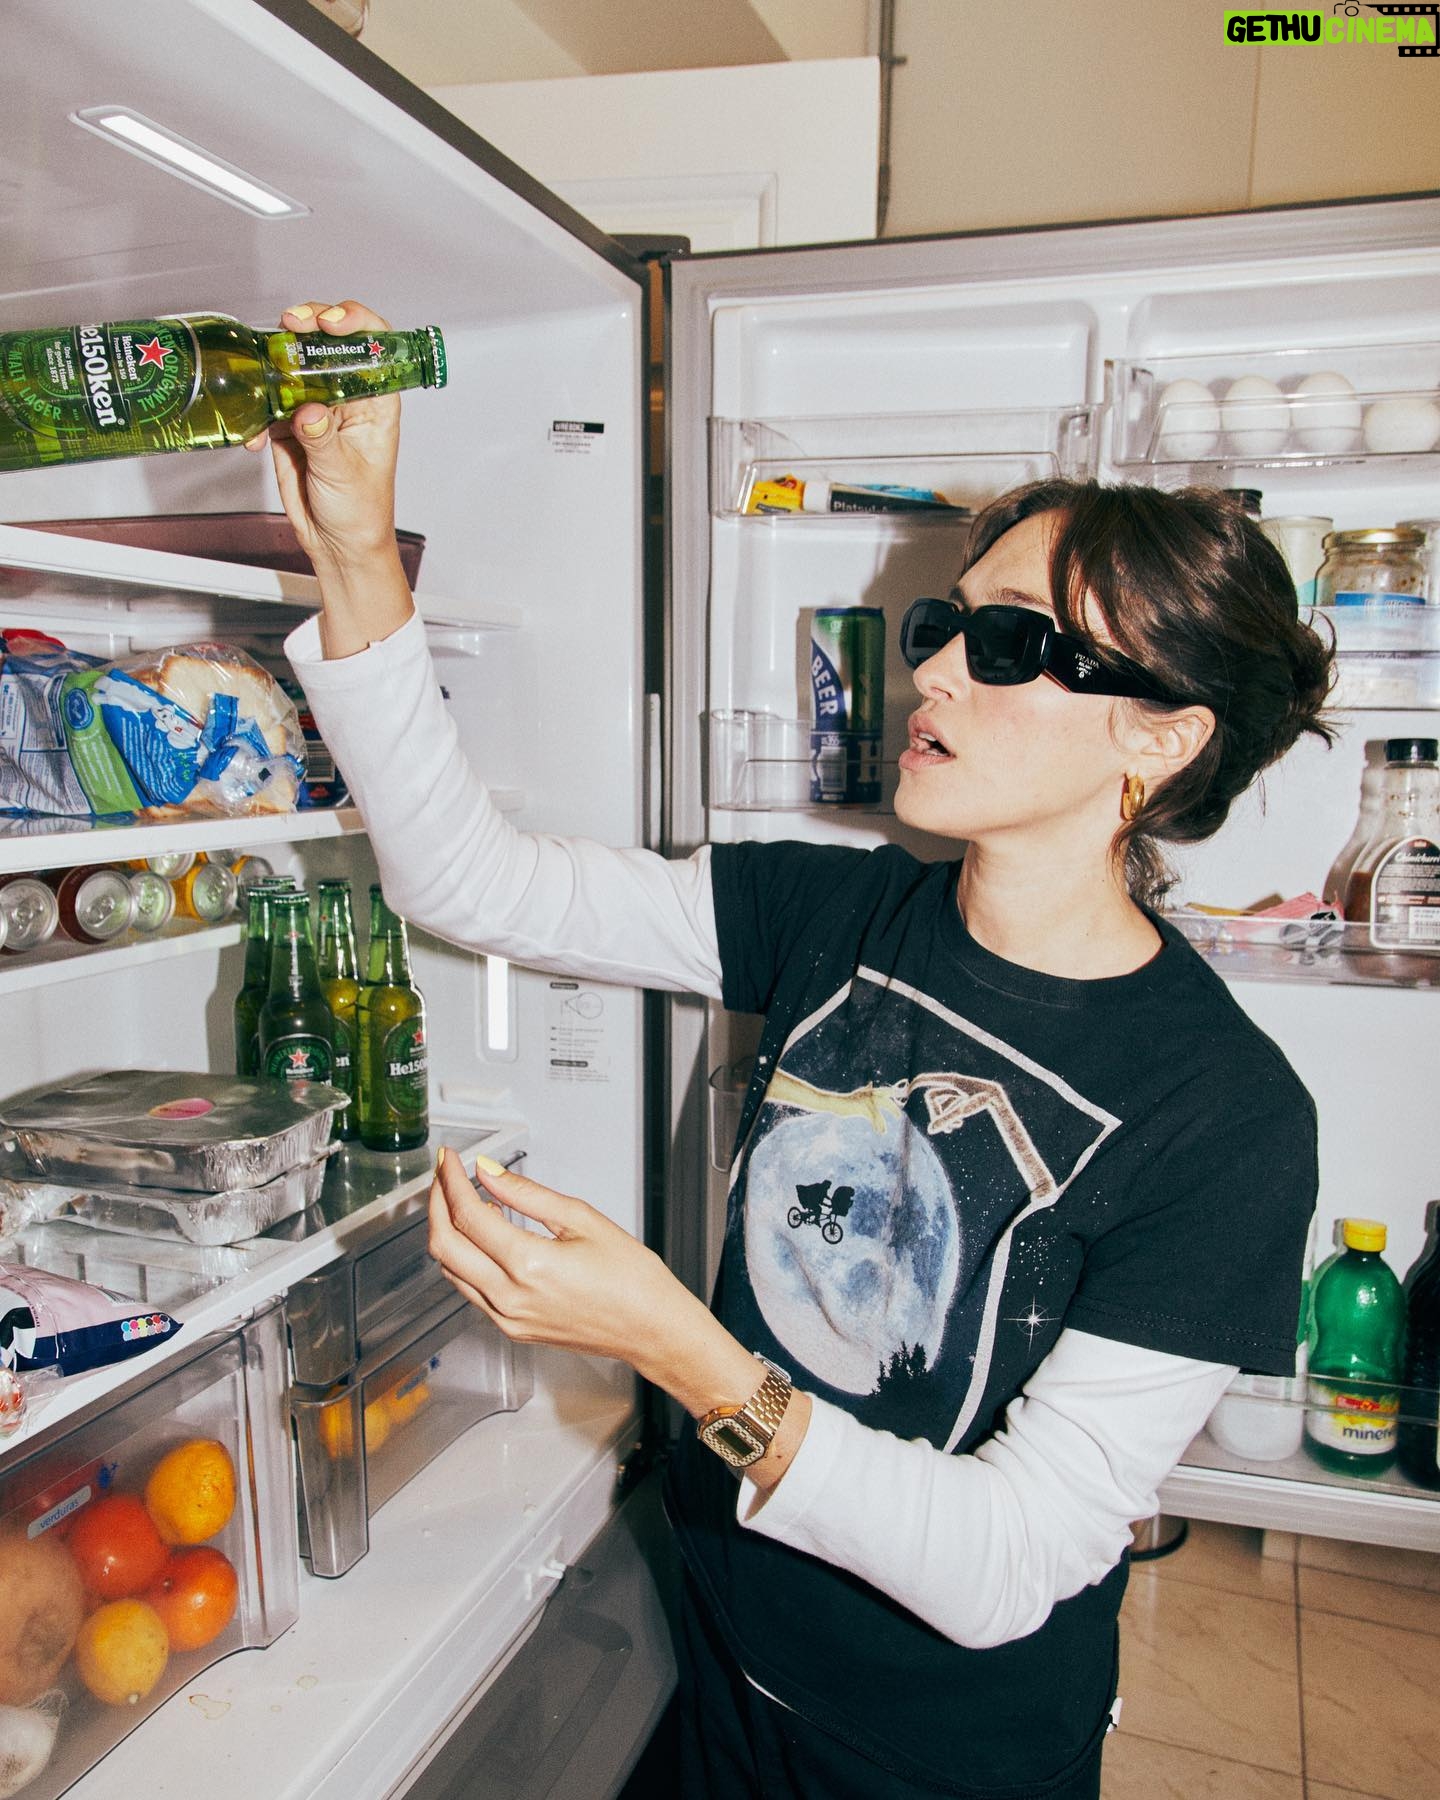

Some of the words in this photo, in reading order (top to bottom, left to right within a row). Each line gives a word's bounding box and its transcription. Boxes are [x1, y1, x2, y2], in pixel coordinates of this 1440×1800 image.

[55, 350, 65, 368] good
[122, 335, 138, 380] Heineken
[306, 343, 365, 357] Heineken
[46, 348, 55, 366] since
[51, 366, 60, 384] 1873
[59, 368, 69, 390] times
[66, 360, 75, 380] name
[118, 368, 127, 380] 150
[8, 350, 26, 383] MALT
[19, 386, 62, 421] LAGER
[137, 354, 179, 412] ORIGINAL
[811, 655, 839, 716] BEER
[40, 1498, 79, 1528] verduras
